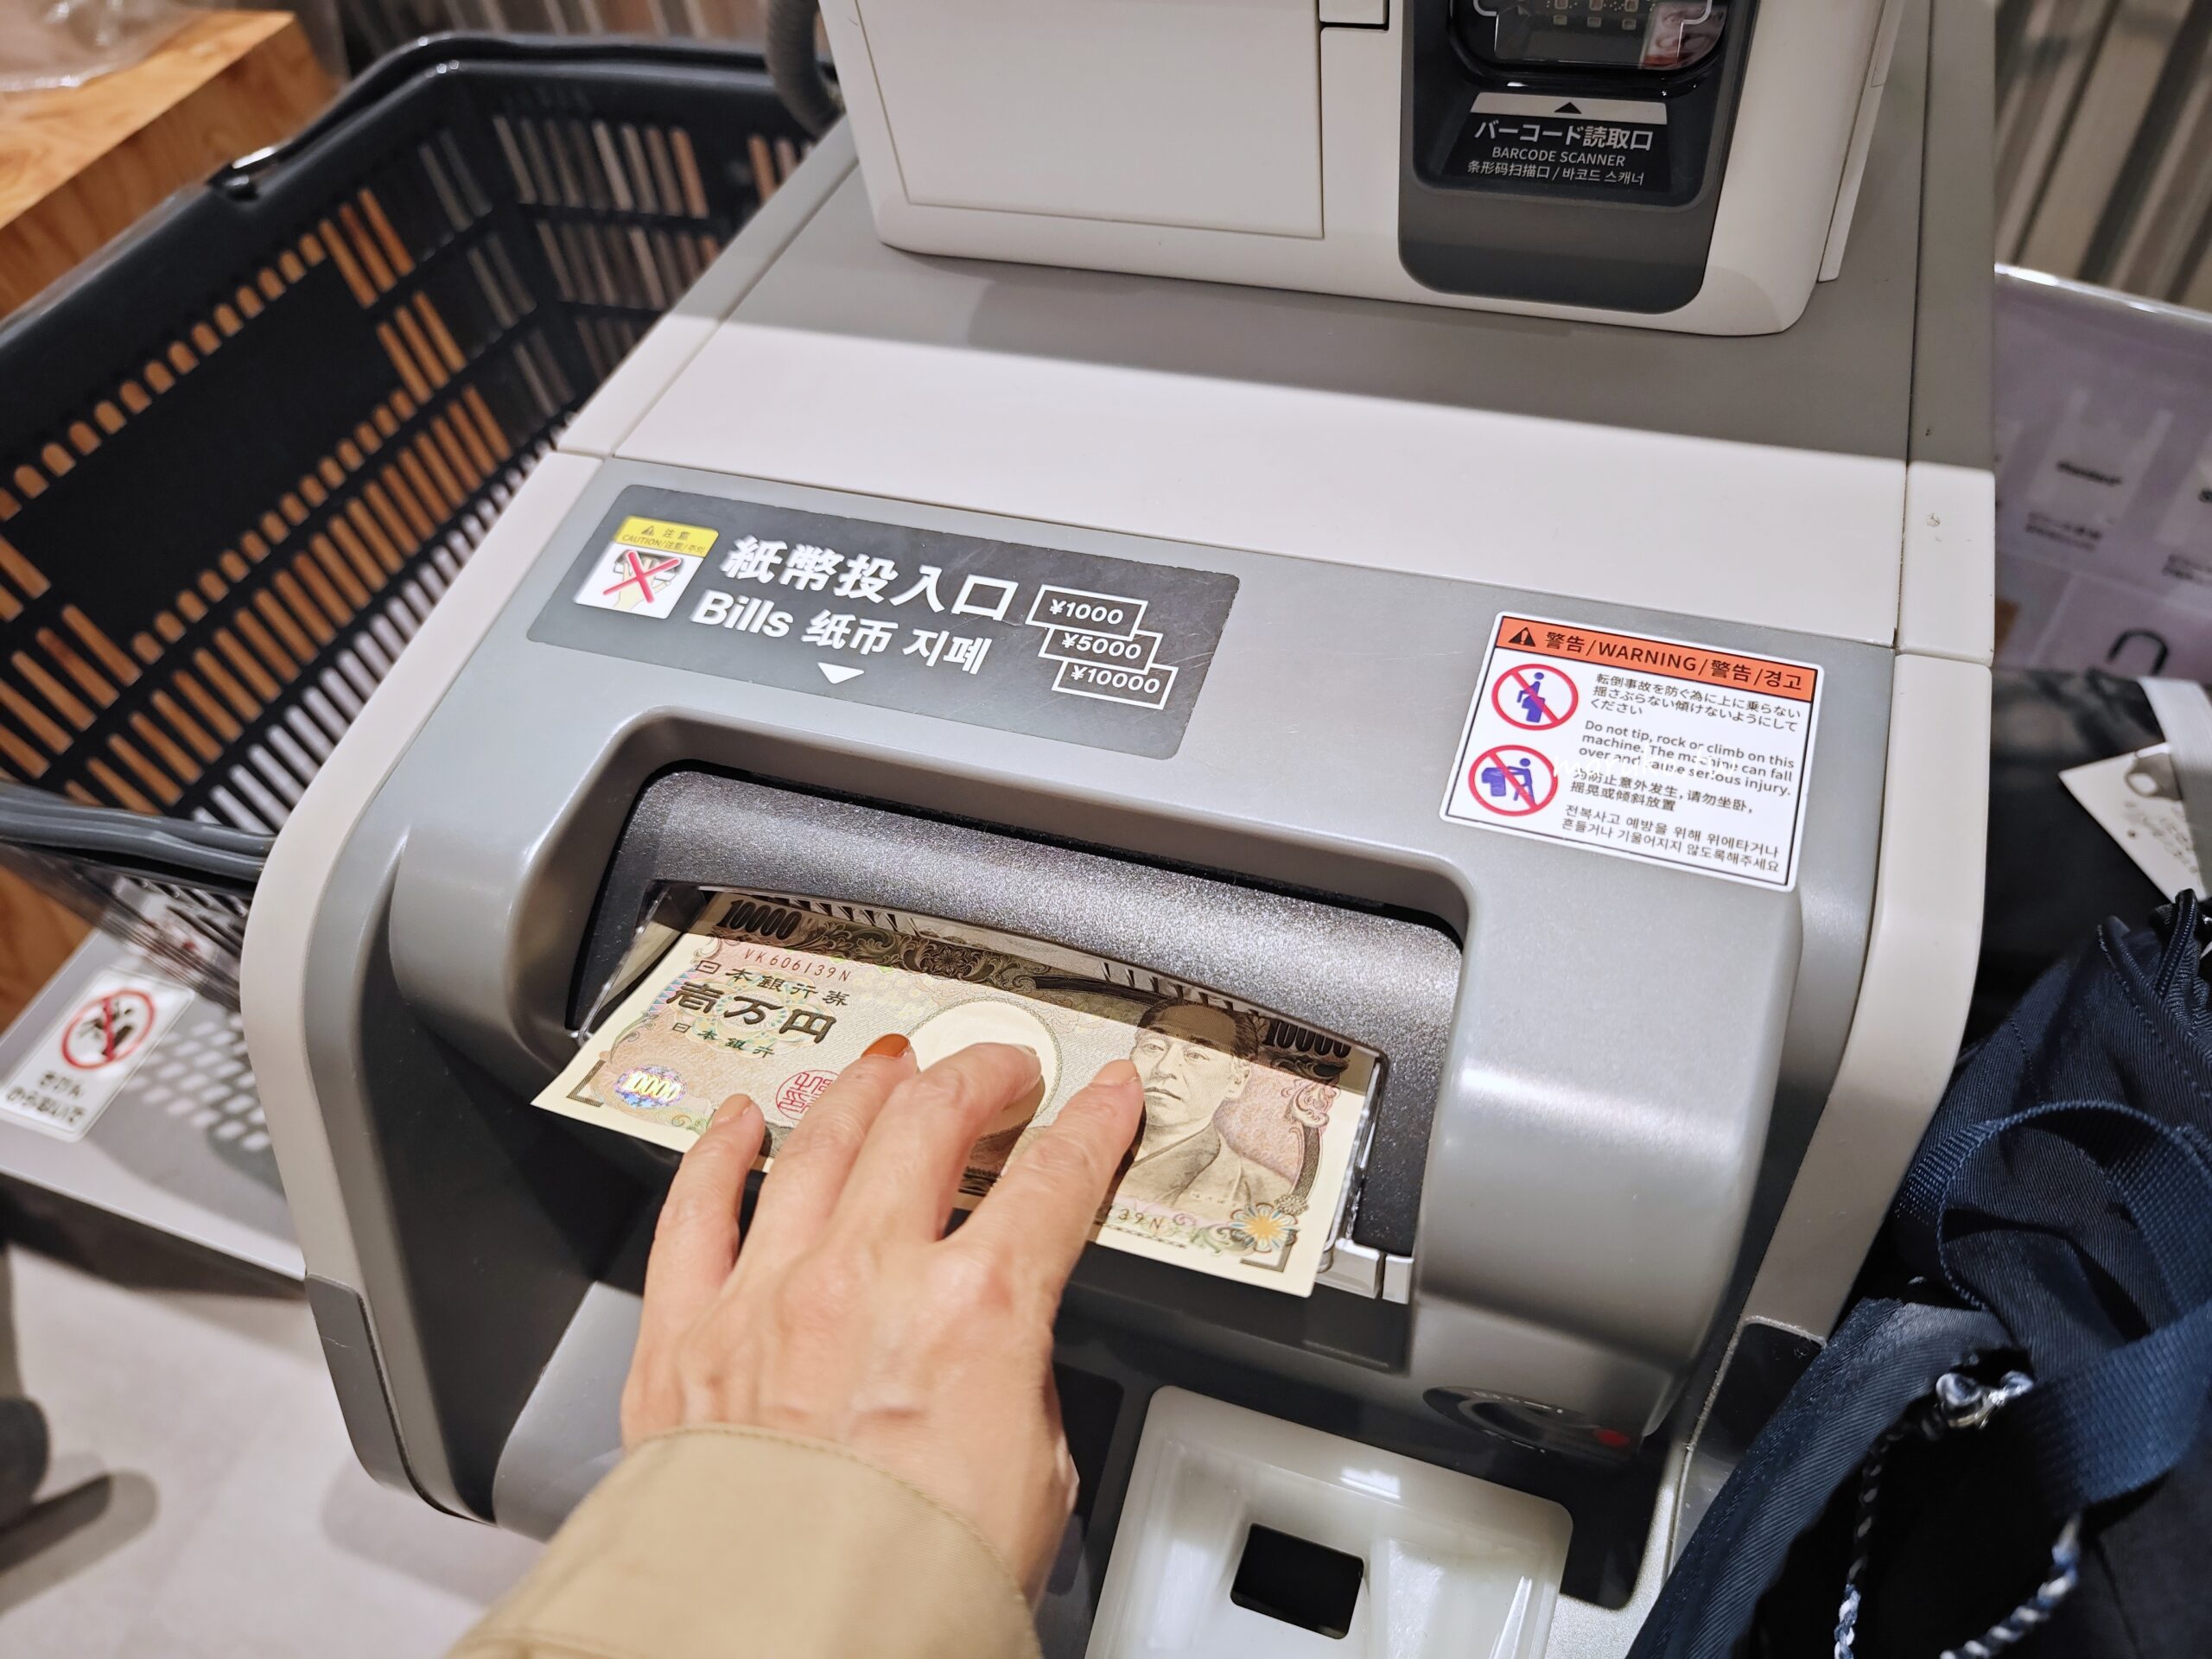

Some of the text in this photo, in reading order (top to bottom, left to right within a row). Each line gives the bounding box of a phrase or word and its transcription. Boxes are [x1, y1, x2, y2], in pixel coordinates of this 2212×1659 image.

[1474, 119, 1653, 151] バーコード読取口
[1467, 159, 1550, 179] 条形码扫描口
[1562, 167, 1600, 181] 바코드
[1604, 171, 1644, 186] 스캐너
[1492, 147, 1625, 167] BARCODE SCANNER
[719, 534, 1020, 621] 紙幣投入口
[1049, 598, 1124, 626] ¥1000
[690, 588, 993, 675] Bills 纸币 지폐
[1061, 632, 1142, 660] ¥5000
[1070, 664, 1160, 695] ¥10000
[1591, 698, 1643, 716] ください
[1582, 734, 1644, 753] machine.
[1649, 745, 1675, 759] The
[1741, 765, 1766, 777] can
[1770, 766, 1793, 782] fall
[1585, 720, 1795, 769] Do not tip, rock or climb on this
[1579, 747, 1611, 760] over
[1744, 777, 1791, 797] injury.
[1570, 780, 1675, 812] 摇晃或倾斜放置
[1561, 817, 1780, 873] 흔들거나 기울어지지 않도록해주세요
[1565, 804, 1779, 859] 전복사고 예방을 위해 위에타거나
[714, 899, 803, 940] 10000
[695, 959, 850, 1007] 日本銀行券
[744, 948, 852, 982] VK606139N
[666, 982, 837, 1044] 壱万円
[672, 1022, 776, 1058] 日本銀行
